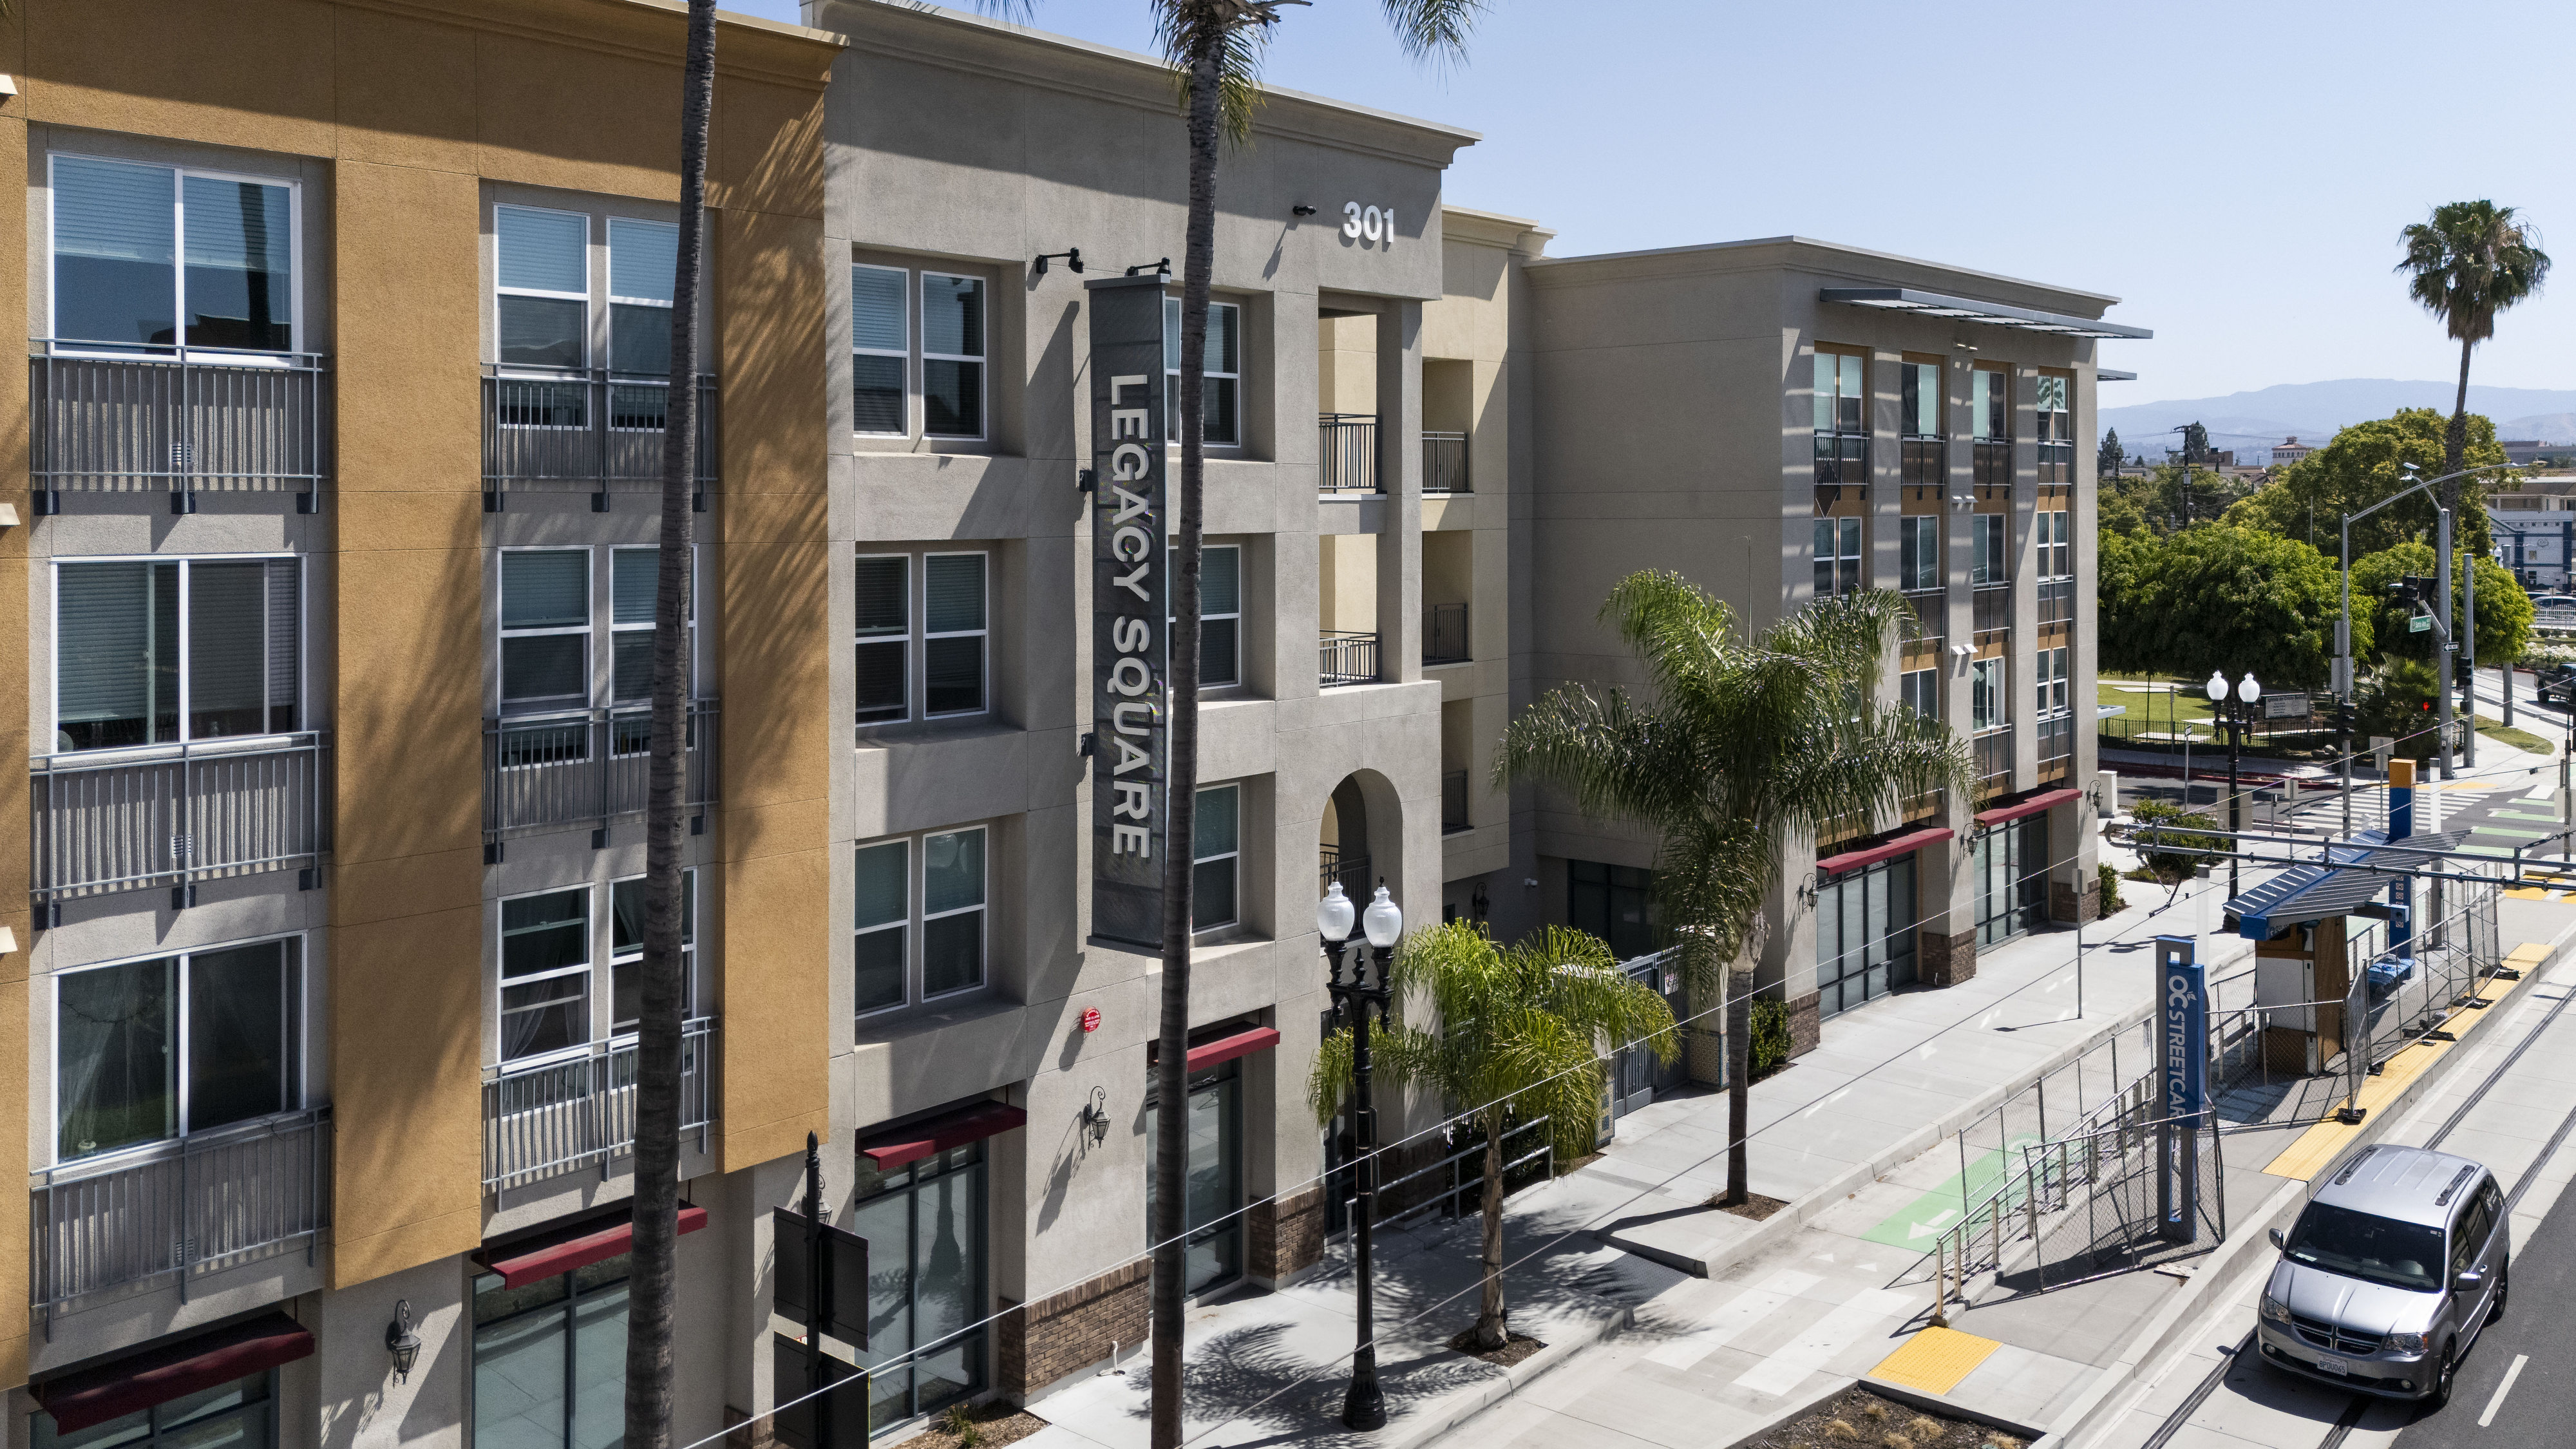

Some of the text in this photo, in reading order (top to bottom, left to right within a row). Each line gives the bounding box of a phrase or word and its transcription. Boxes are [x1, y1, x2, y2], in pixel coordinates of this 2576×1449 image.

[1342, 201, 1394, 243] 301
[1107, 374, 1151, 858] LEGACY SQUARE
[2168, 975, 2188, 1119] OC STREETCAR
[2319, 1360, 2345, 1374] 8PDU065
